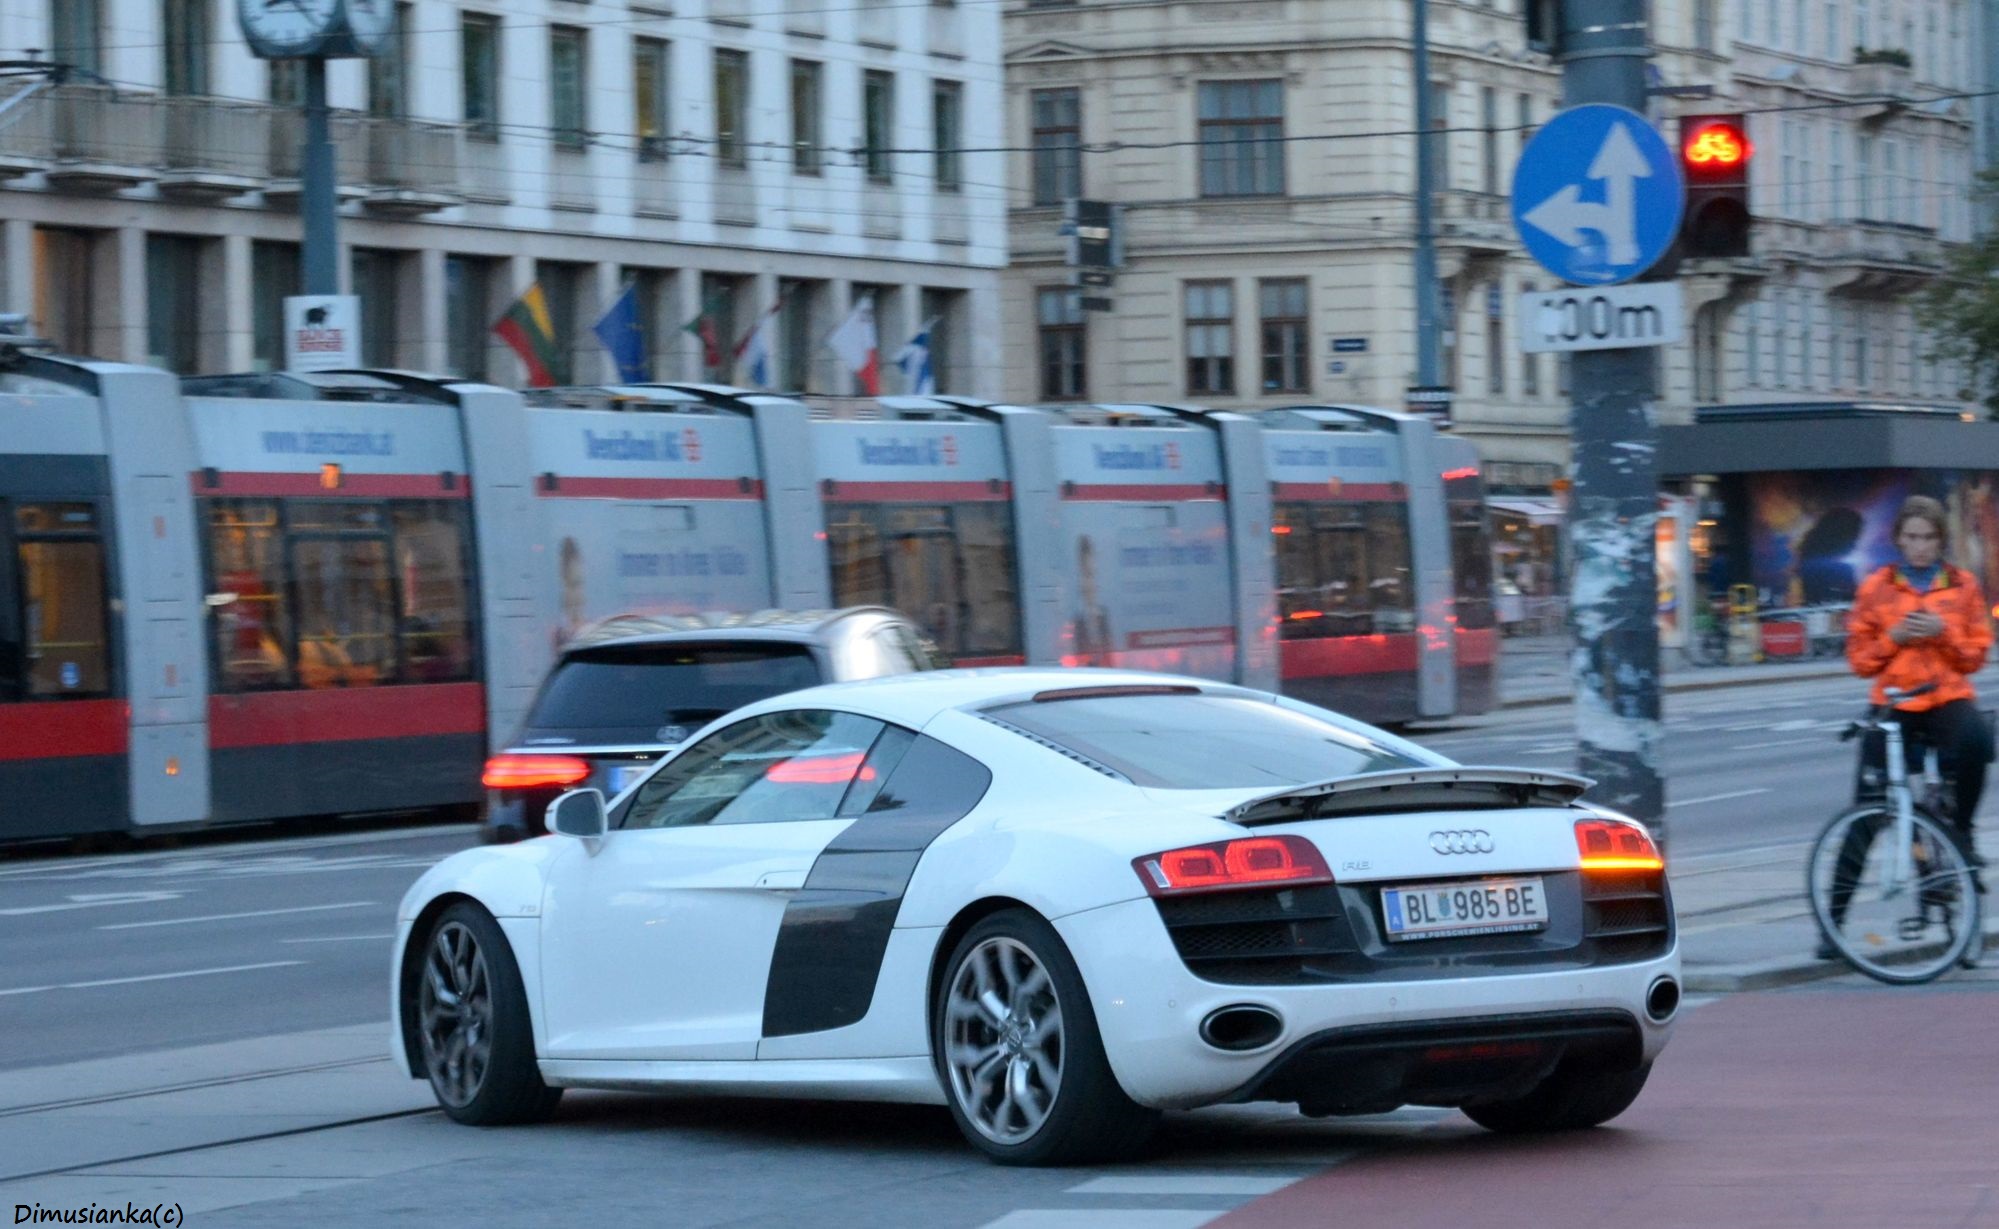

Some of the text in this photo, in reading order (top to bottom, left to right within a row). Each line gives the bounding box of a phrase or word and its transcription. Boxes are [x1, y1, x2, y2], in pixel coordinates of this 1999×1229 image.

[1541, 296, 1663, 343] 00m
[1406, 886, 1536, 924] BL 985 BE
